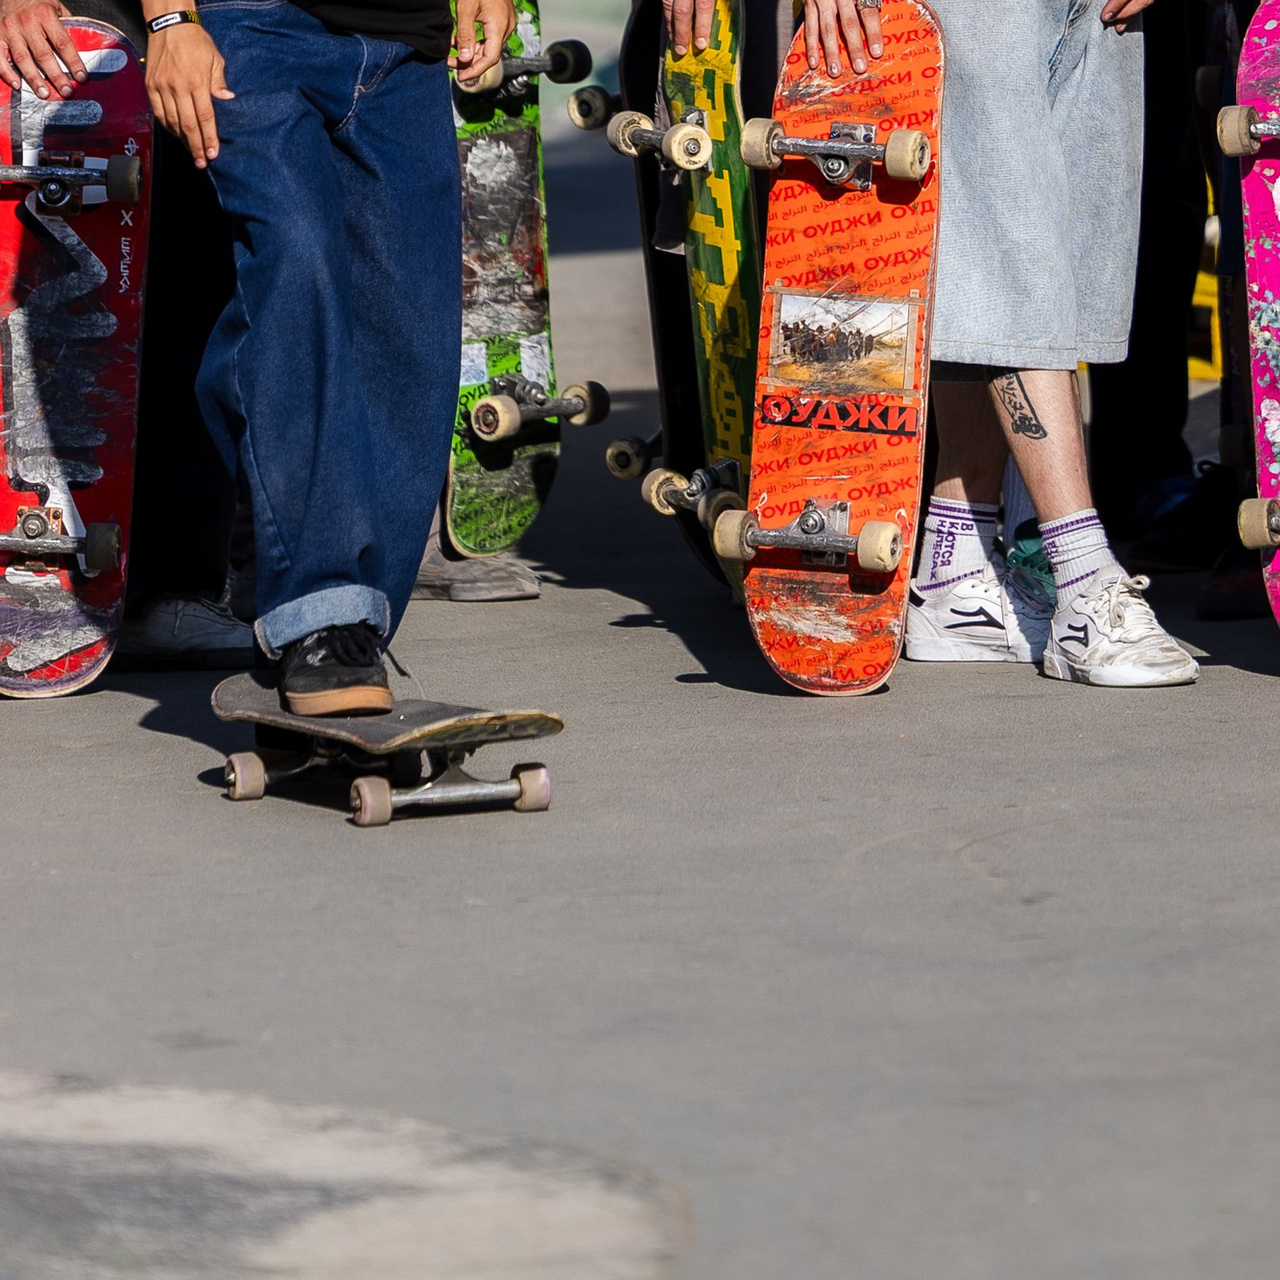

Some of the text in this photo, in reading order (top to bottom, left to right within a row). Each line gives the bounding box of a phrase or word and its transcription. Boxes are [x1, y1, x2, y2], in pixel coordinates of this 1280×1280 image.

[803, 211, 881, 239] ОУДЖИ
[763, 396, 917, 432] ОУДЖИ
[798, 438, 878, 466] ОУДЖИ
